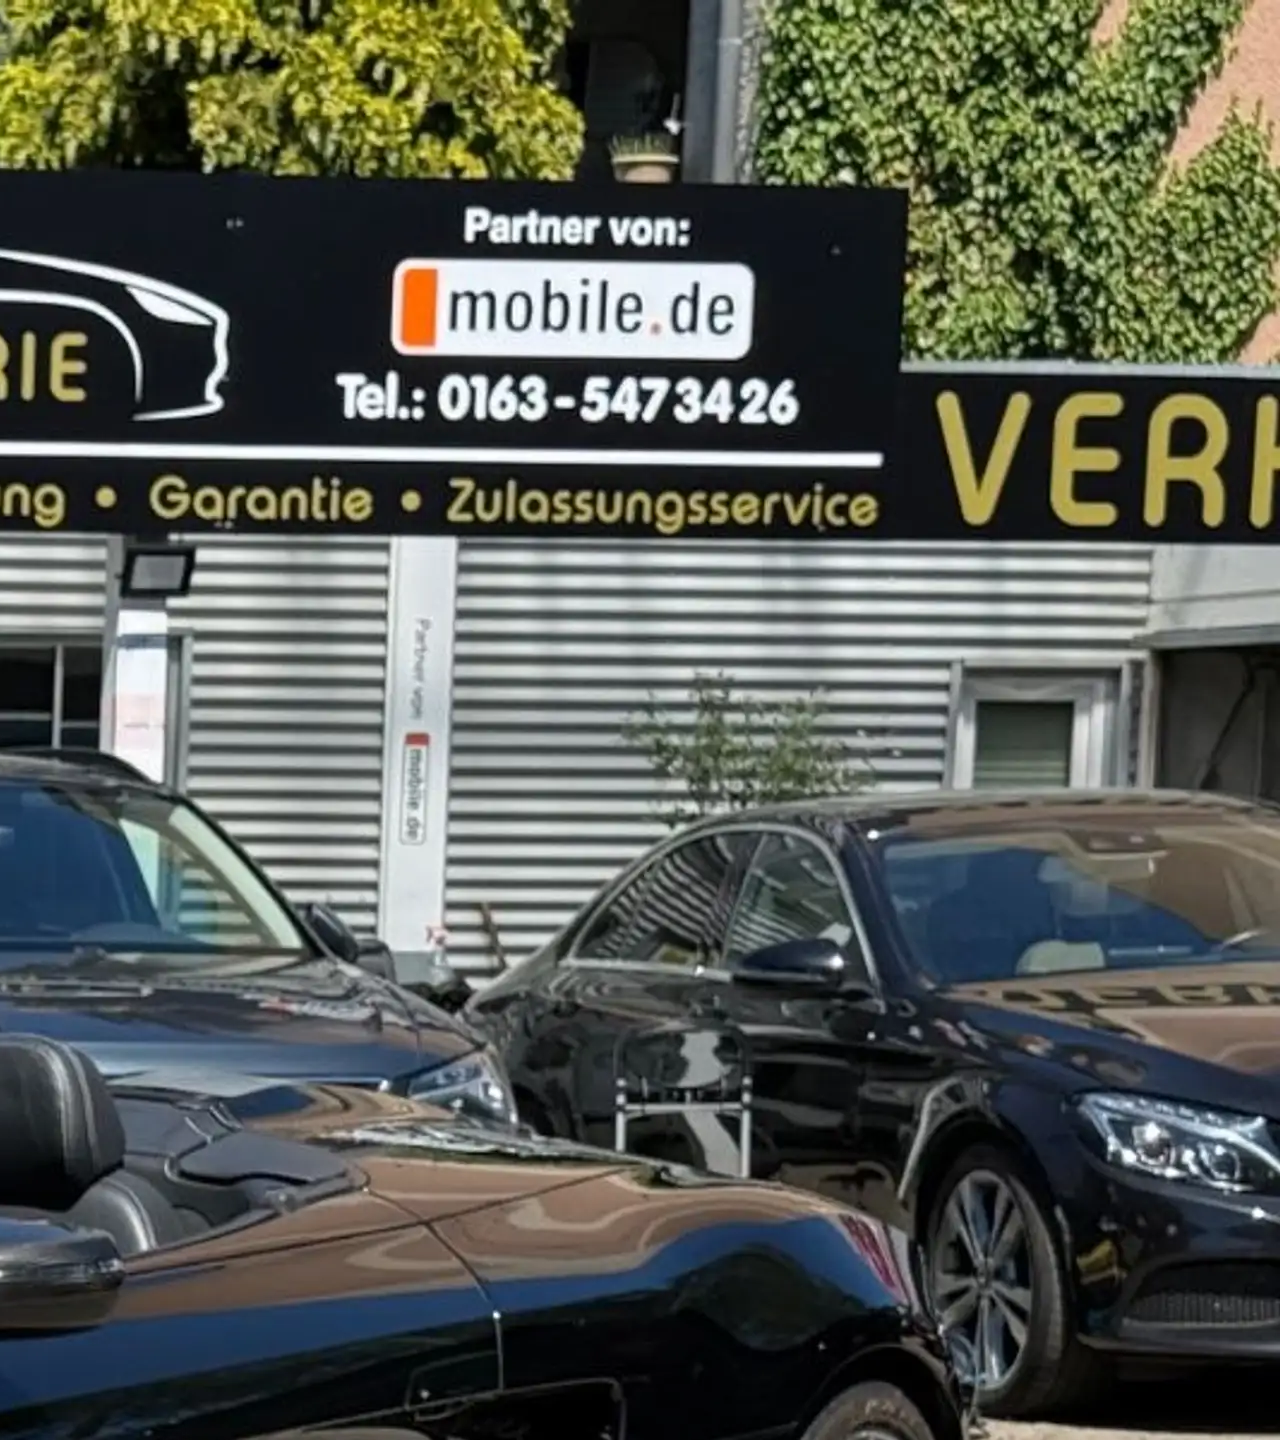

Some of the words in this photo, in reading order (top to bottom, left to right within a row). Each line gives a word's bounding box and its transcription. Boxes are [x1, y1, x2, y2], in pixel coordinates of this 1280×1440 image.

[463, 206, 602, 245] Partner
[607, 216, 691, 247] von:
[448, 278, 736, 337] mobile.de
[335, 370, 427, 421] Tel.:
[149, 475, 374, 522] Garantie
[446, 478, 878, 535] Zulassungsservice
